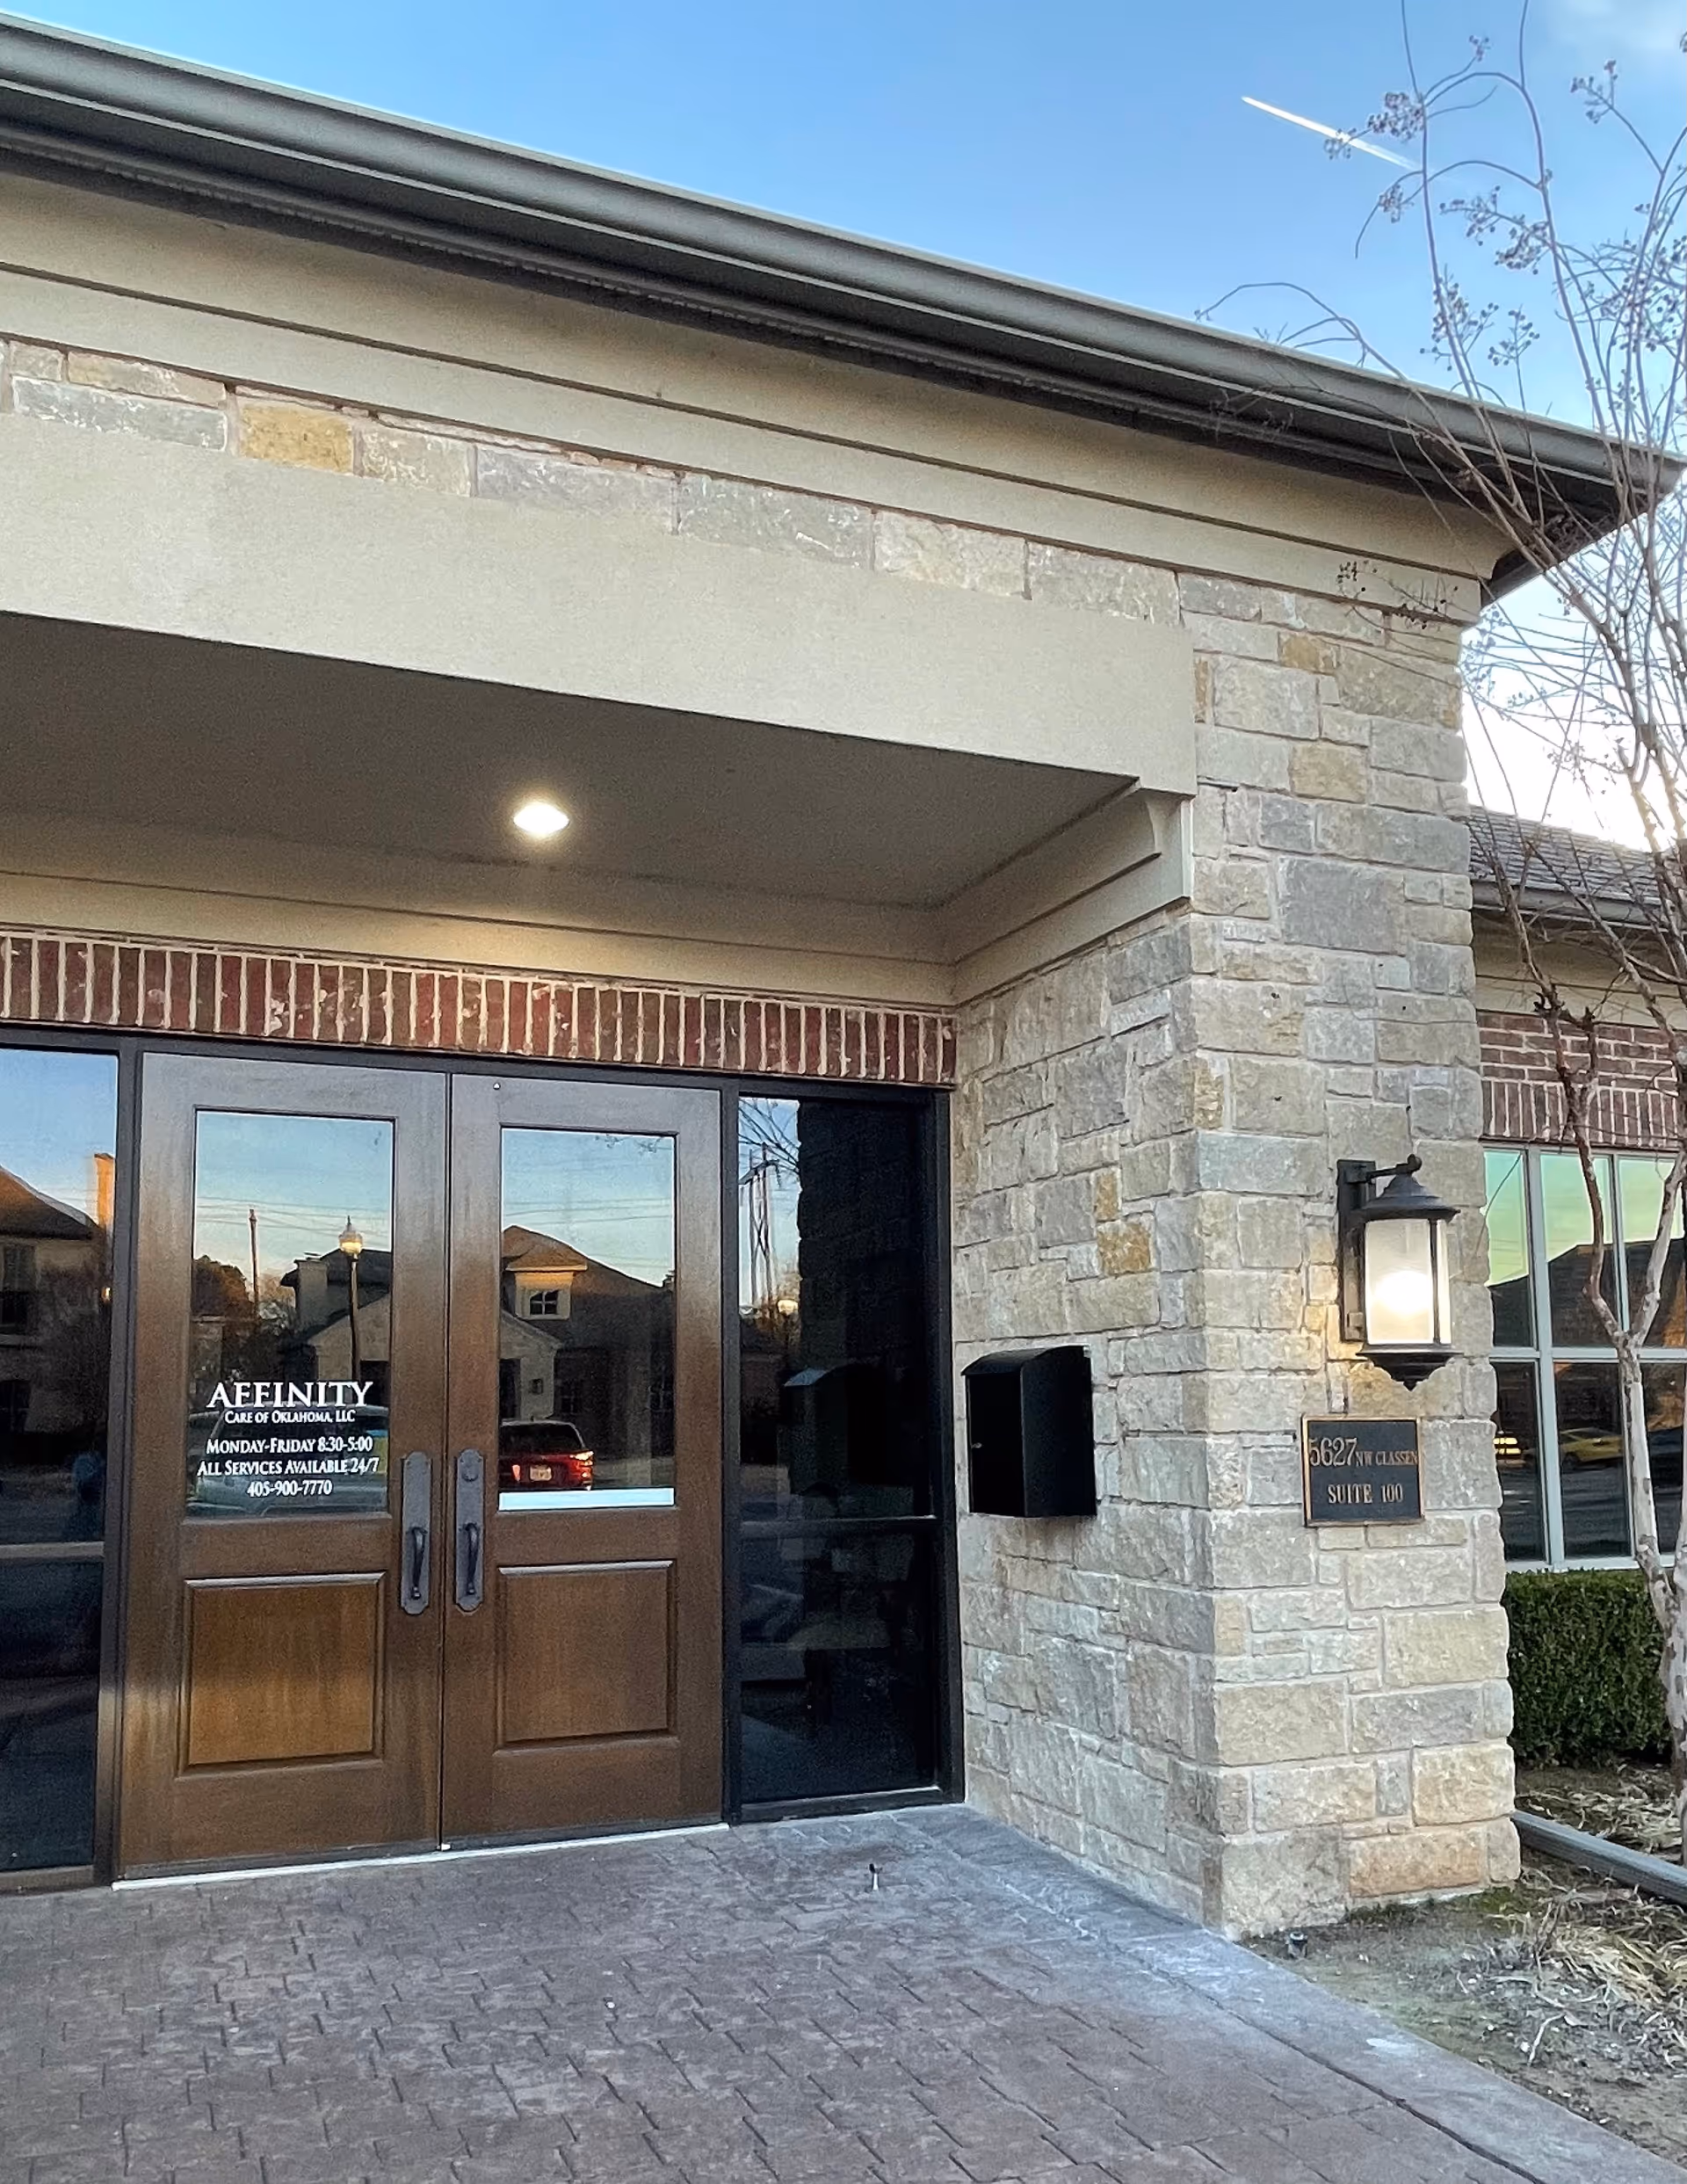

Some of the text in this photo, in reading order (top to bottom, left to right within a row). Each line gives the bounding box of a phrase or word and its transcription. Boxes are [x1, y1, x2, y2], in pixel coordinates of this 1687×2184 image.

[206, 1382, 373, 1408] AFFINITY
[224, 1410, 356, 1424] CARE OF OKLAHOMA, LLC
[206, 1436, 373, 1455] MONDAY-FRIDAY 8:30-5:00
[1308, 1437, 1418, 1467] 5627 NW CLASSEN
[197, 1457, 380, 1477] ALL SERVICES AVAILABLE 24/7
[247, 1479, 333, 1497] 405-900-7770
[1328, 1483, 1403, 1504] SUITE 100
